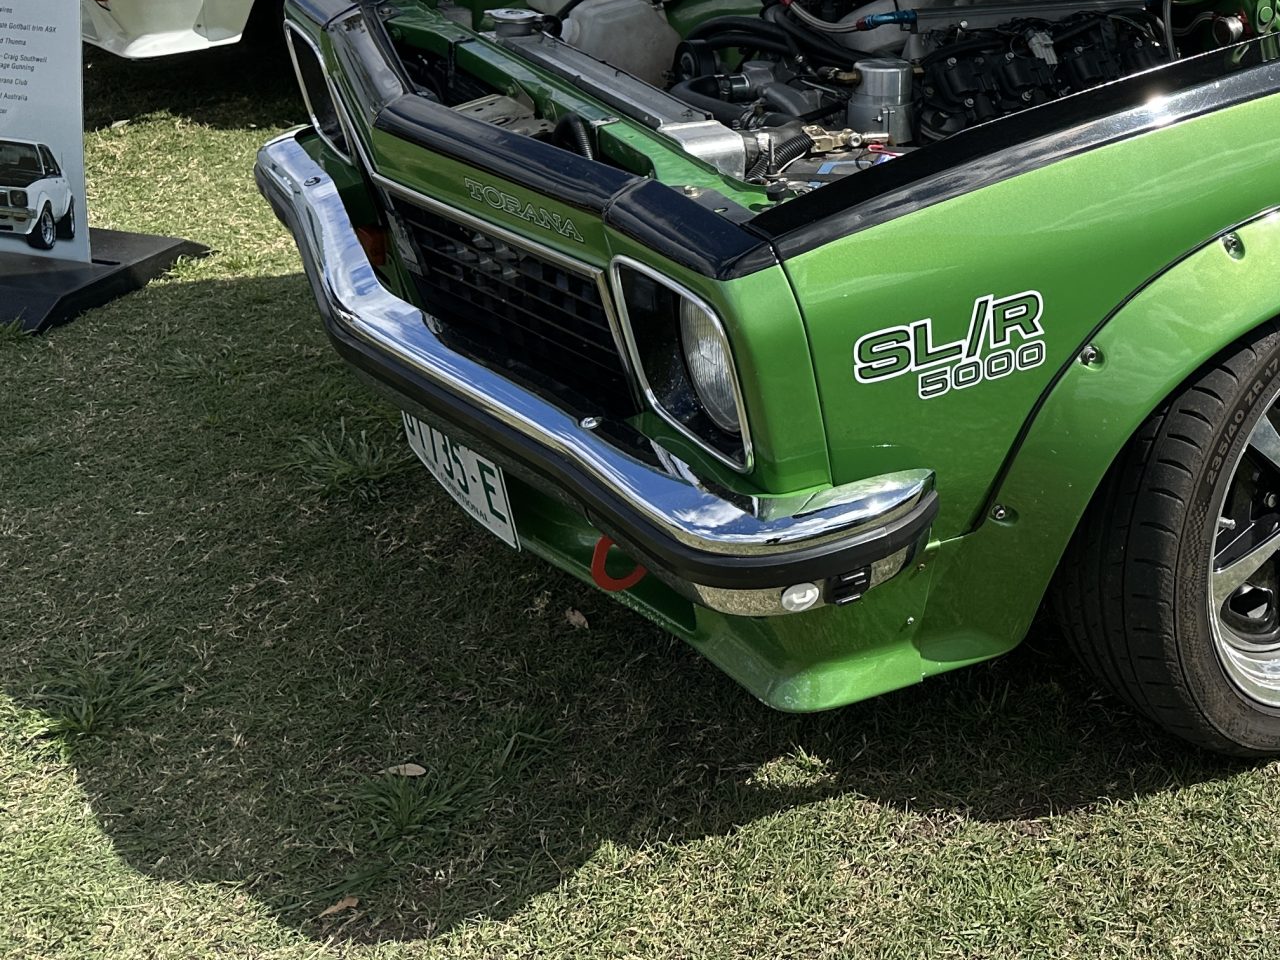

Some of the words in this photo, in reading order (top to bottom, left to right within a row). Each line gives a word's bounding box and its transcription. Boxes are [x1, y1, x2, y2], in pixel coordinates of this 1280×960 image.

[3, 52, 18, 62] Craig
[20, 54, 48, 63] Southwell
[14, 78, 28, 86] Club
[464, 176, 585, 243] TORANA
[853, 289, 1045, 385] SL/R
[917, 339, 1046, 400] 5000
[1206, 408, 1245, 486] 235/40
[1244, 380, 1266, 407] ZR
[1264, 357, 1279, 379] 17
